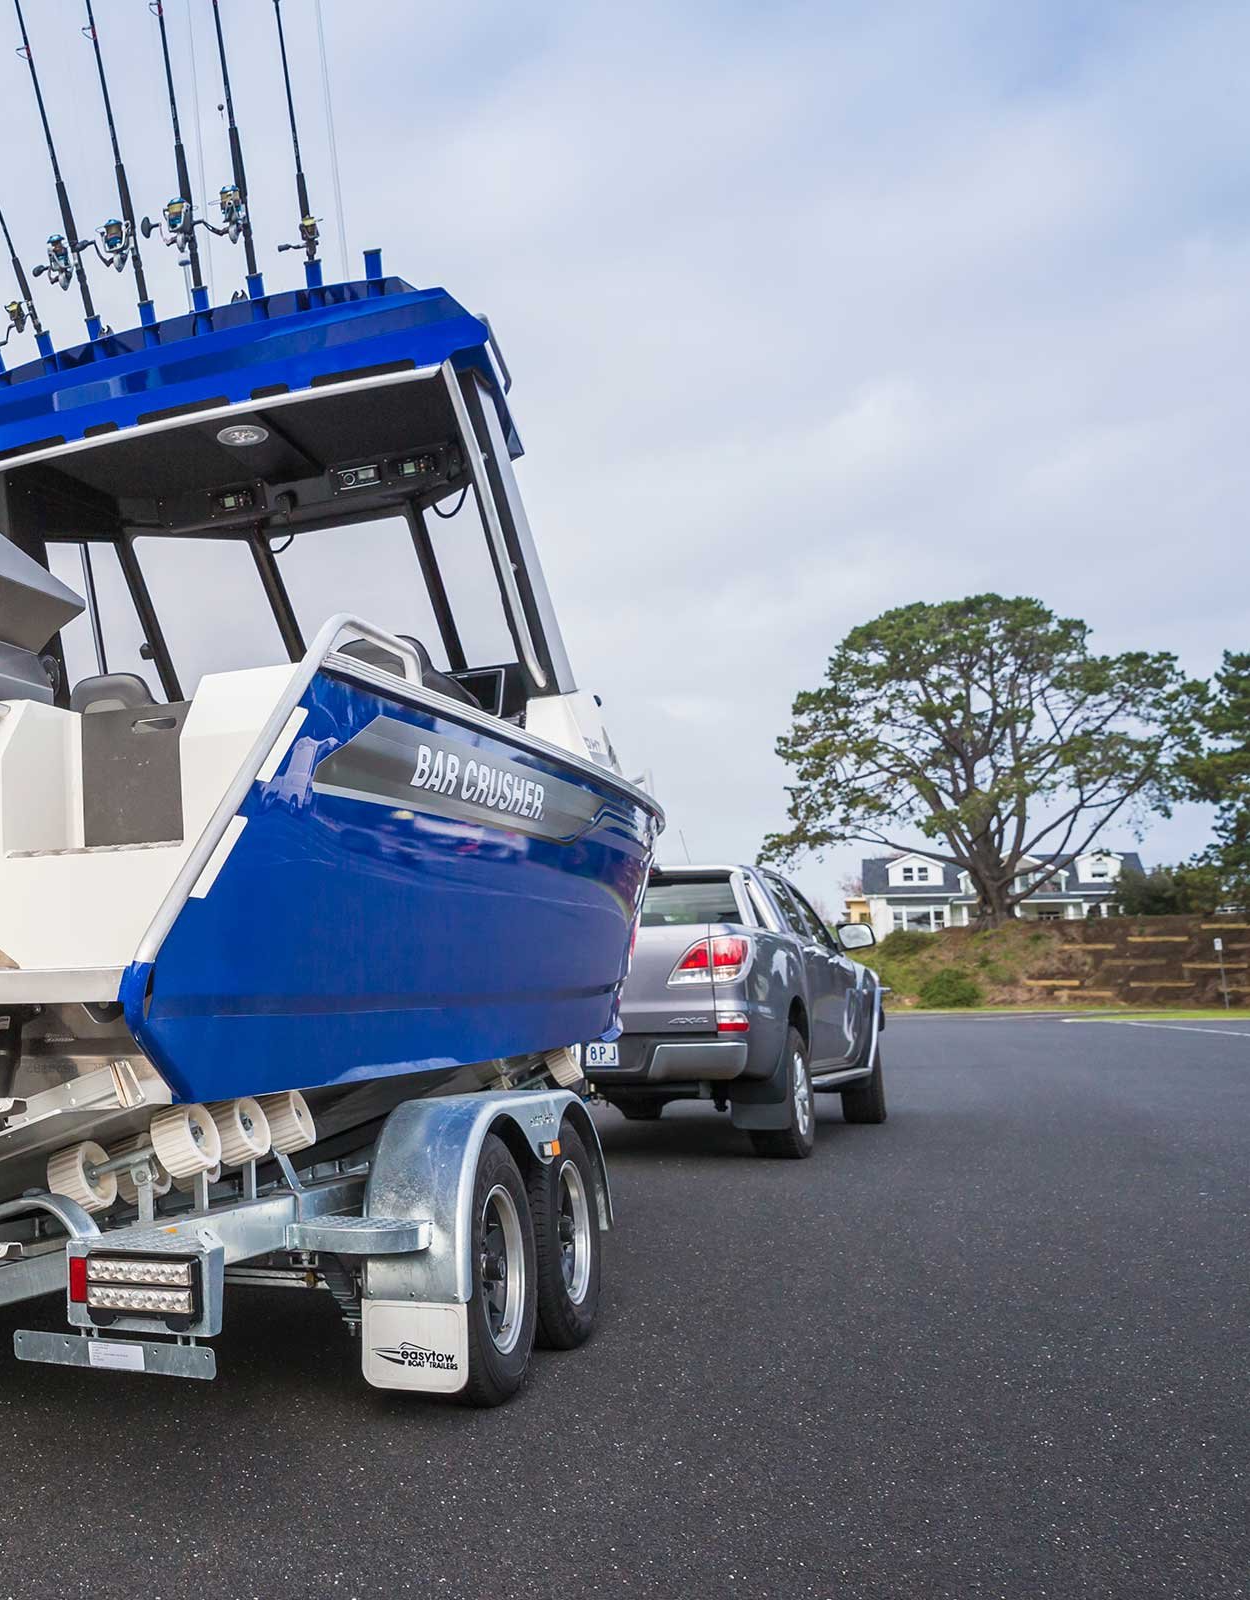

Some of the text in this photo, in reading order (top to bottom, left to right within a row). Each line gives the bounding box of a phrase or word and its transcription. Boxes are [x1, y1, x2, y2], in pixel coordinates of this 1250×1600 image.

[410, 744, 546, 820] BAR CRUSHER
[400, 1350, 455, 1363] easytow
[407, 1360, 459, 1371] BOAT TRAILERS
